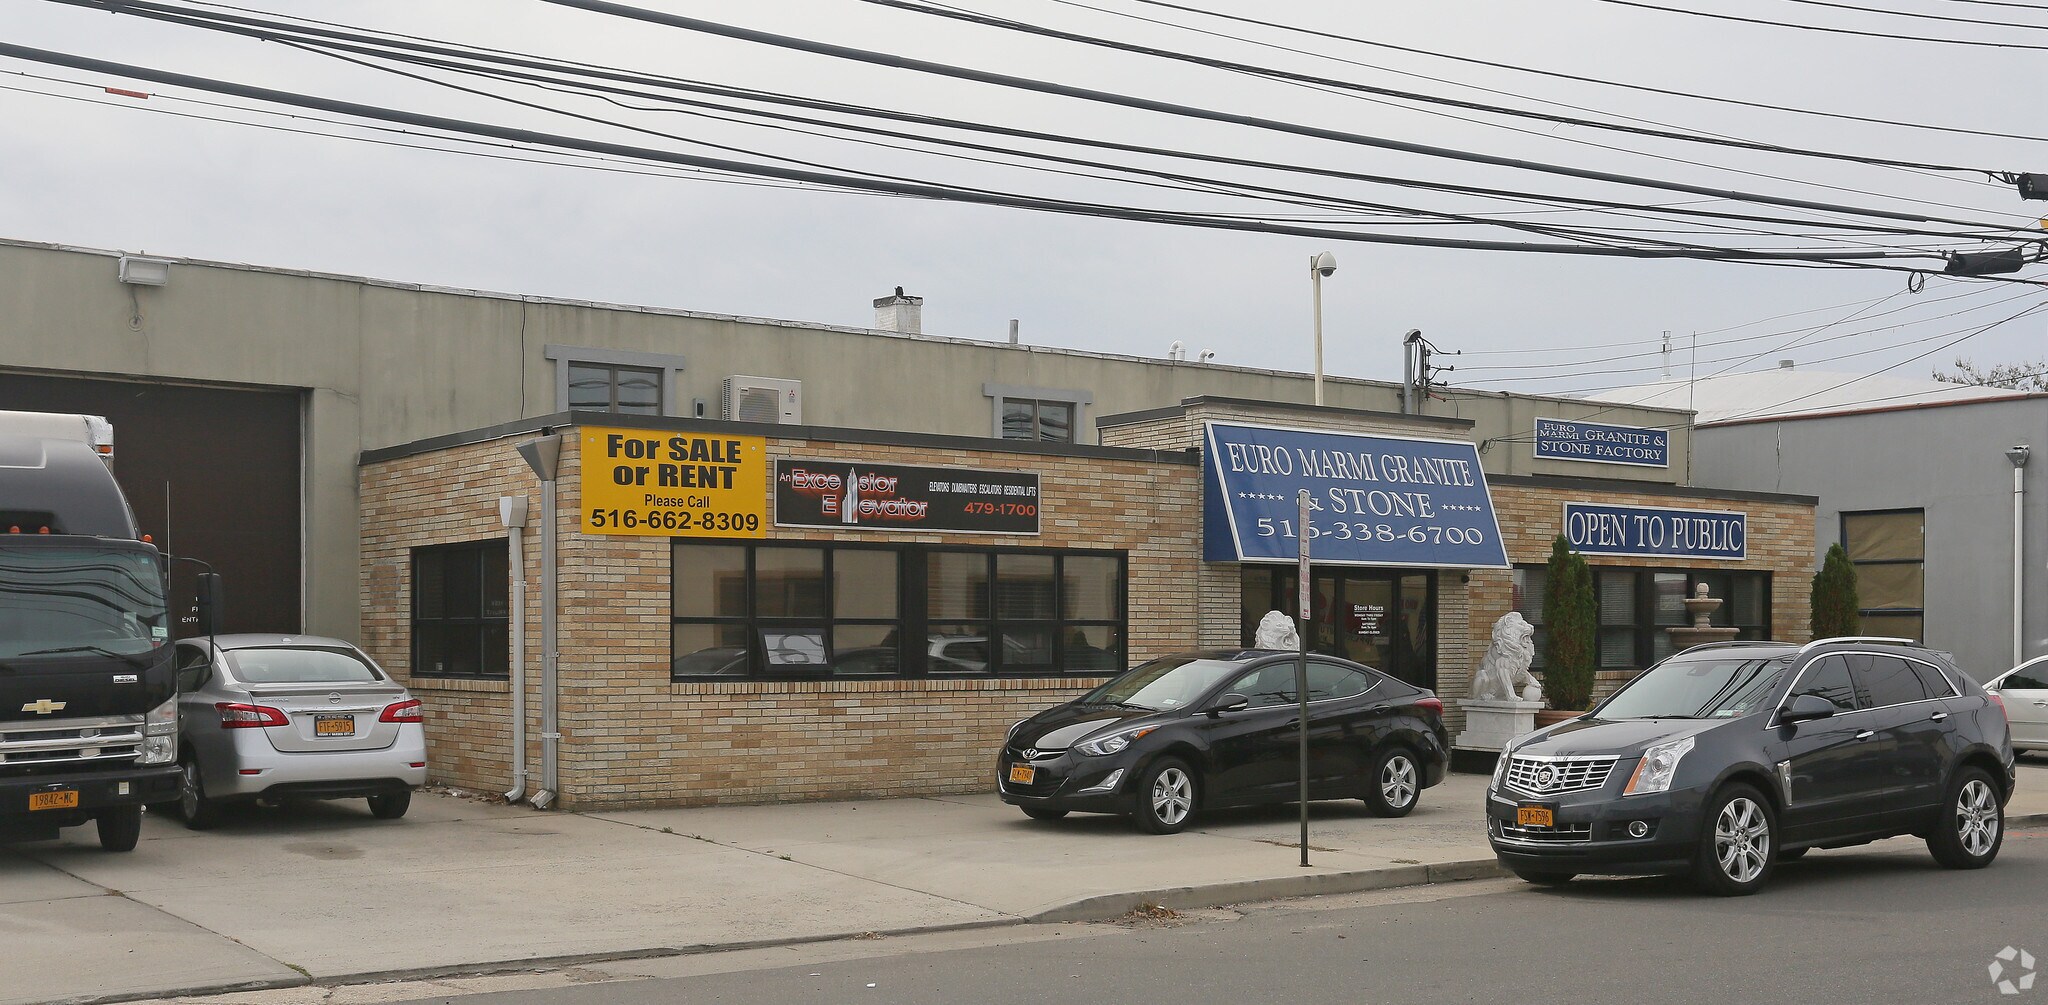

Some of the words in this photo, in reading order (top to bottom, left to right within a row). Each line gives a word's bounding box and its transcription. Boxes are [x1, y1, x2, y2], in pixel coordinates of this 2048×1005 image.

[1539, 429, 1580, 440] MARMI
[1544, 423, 1576, 433] EURO
[1585, 430, 1650, 446] GRANITE
[1653, 436, 1665, 447] &
[606, 434, 661, 459] For
[668, 437, 742, 464] SALE
[1541, 441, 1591, 455] STONE
[1595, 445, 1662, 461] FACTORY
[1225, 442, 1293, 476] EURO
[1297, 447, 1379, 482] MARMI
[1381, 453, 1475, 488] GRANITE
[613, 465, 649, 486] or
[658, 464, 737, 490] RENT
[779, 472, 791, 482] An
[644, 494, 684, 508] Please
[687, 495, 710, 508] Call
[964, 502, 1036, 516] 479-1700
[1328, 487, 1435, 519] STONE
[591, 508, 759, 532] 516-662-8309
[1568, 511, 1628, 547] OPEN
[1633, 515, 1665, 549] TO
[1671, 517, 1743, 552] PUBLIC
